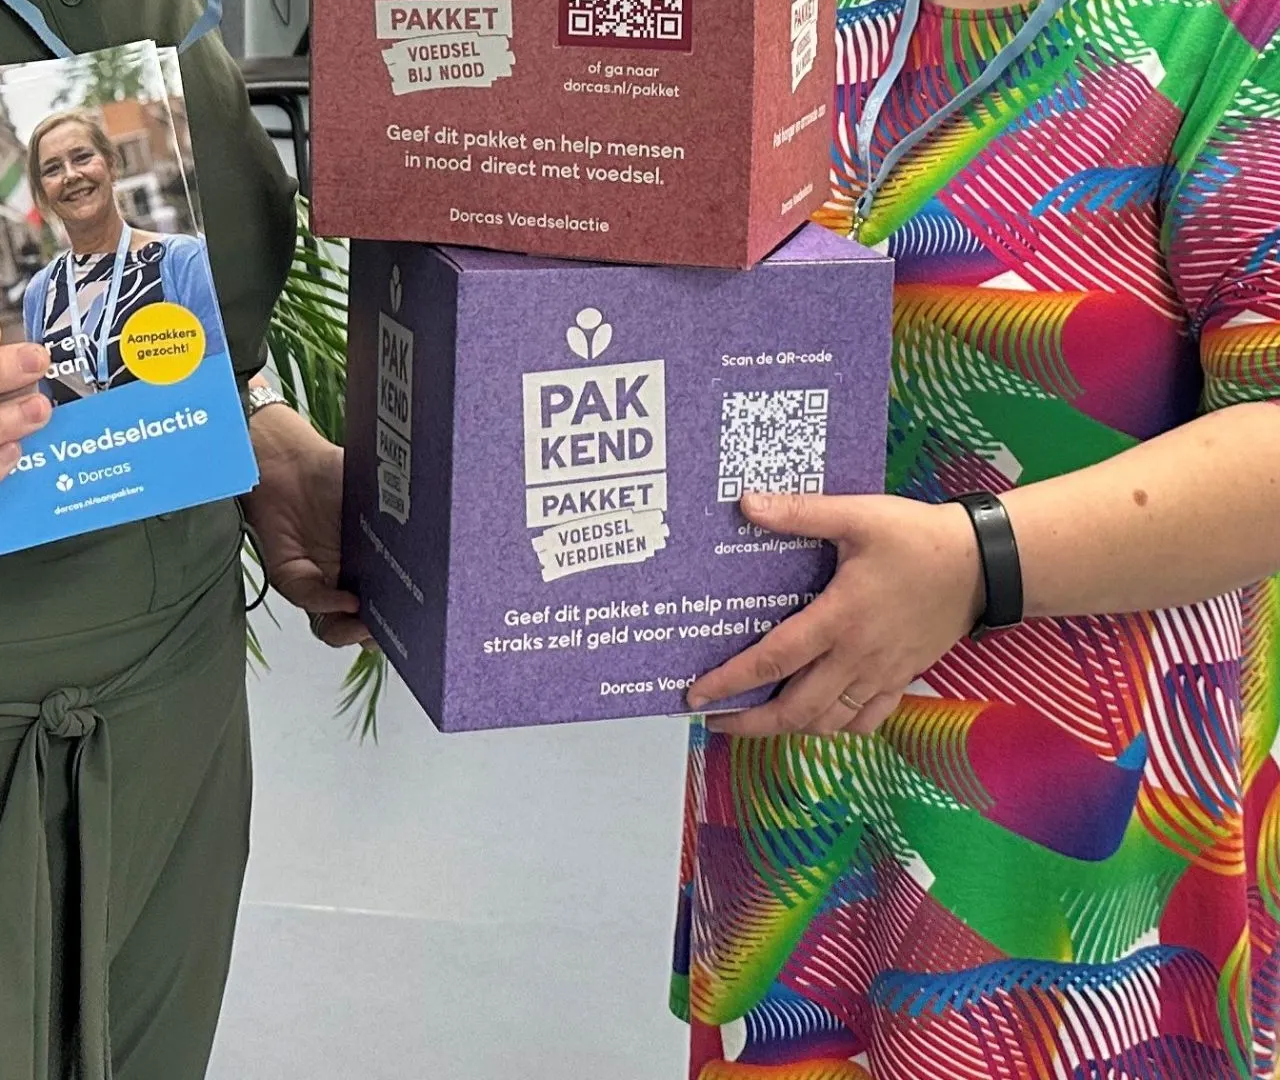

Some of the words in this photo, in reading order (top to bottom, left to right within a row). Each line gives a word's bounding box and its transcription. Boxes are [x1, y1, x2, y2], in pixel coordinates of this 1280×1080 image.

[390, 8, 499, 31] PAKKET
[407, 42, 480, 62] VOEDSEL
[408, 64, 432, 83] BIJ
[440, 62, 485, 81] NOOD
[588, 62, 602, 76] of
[604, 65, 623, 78] ga
[627, 64, 659, 77] naar
[563, 80, 680, 99] dorcas.nl/pakket
[387, 124, 429, 143] Geef
[434, 127, 459, 145] dit
[464, 130, 526, 151] pakket
[532, 137, 556, 151] en
[561, 136, 602, 158] help
[607, 143, 685, 160] mensen
[405, 152, 421, 168] in
[425, 154, 471, 172] nood
[480, 157, 536, 176] direct
[541, 162, 581, 179] met
[586, 164, 665, 186] voedsel.
[450, 208, 503, 225] Dorcas
[507, 211, 610, 233] Voedselactie
[61, 334, 90, 352] en
[127, 328, 197, 345] Aanpakkers
[137, 343, 189, 360] gezocht!
[382, 327, 409, 384] PAK
[721, 352, 752, 367] Scan
[756, 352, 772, 366] de
[776, 349, 833, 365] QR-code
[381, 376, 409, 423] KEND
[539, 374, 650, 428] PAK
[50, 407, 209, 463] Voedselactie
[540, 428, 653, 471] KEND
[78, 461, 132, 485] Dorcas
[542, 483, 654, 518] PAKKET
[558, 519, 634, 547] VOEDSEL
[738, 522, 751, 535] of
[555, 536, 648, 569] VERDIENEN
[504, 606, 551, 627] Geef
[555, 602, 581, 623] dit
[585, 600, 649, 625] pakket
[654, 600, 677, 615] en
[682, 595, 722, 615] help
[726, 593, 799, 611] mensen
[483, 633, 543, 654] straks
[548, 628, 583, 650] zelf
[587, 626, 629, 650] geld
[633, 627, 674, 642] voor
[679, 617, 750, 639] voedsel
[753, 618, 772, 634] te
[600, 680, 654, 695] Dorcas
